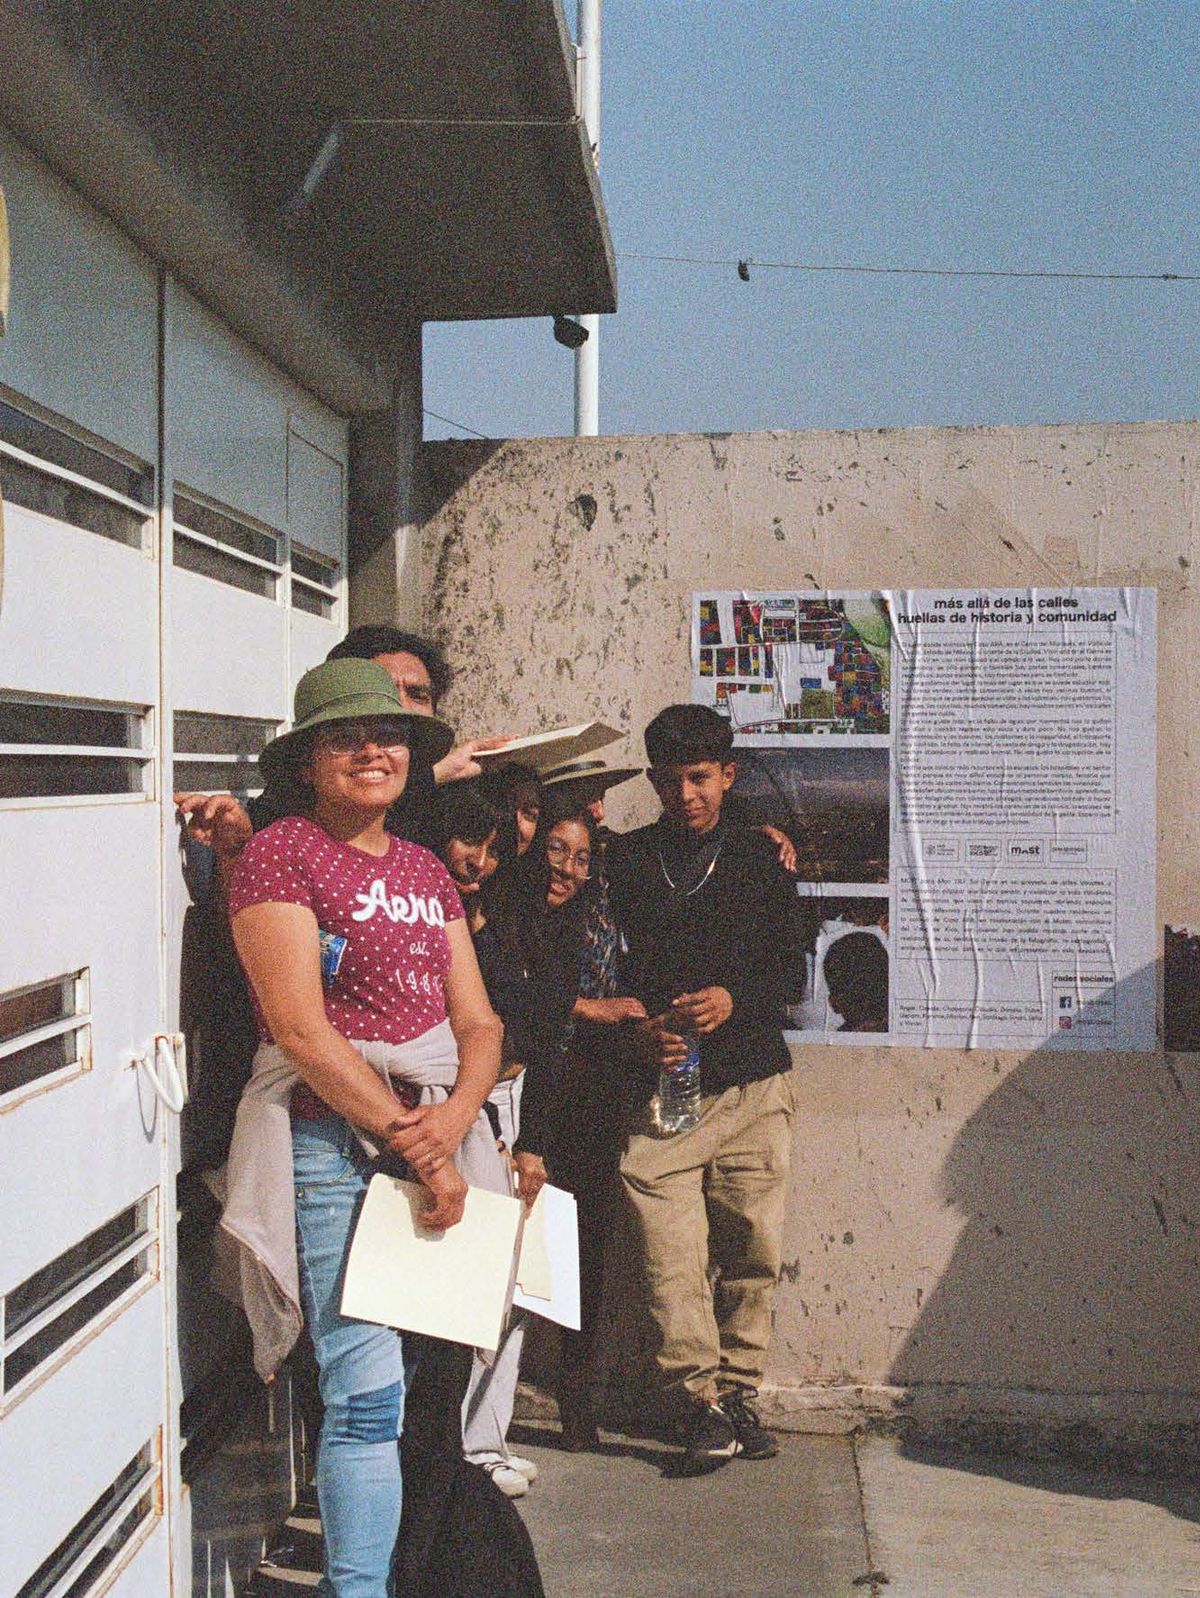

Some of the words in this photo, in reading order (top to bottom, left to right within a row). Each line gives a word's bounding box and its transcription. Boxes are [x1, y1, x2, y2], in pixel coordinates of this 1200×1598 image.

[934, 597, 963, 609] más
[967, 597, 989, 609] allá
[993, 597, 1011, 609] de
[1015, 597, 1034, 609] las
[1038, 596, 1079, 608] calles
[898, 612, 946, 624] huellas
[949, 612, 967, 624] de
[970, 611, 1023, 623] historia
[1026, 613, 1034, 625] y
[1038, 610, 1117, 622] comunidad
[351, 879, 446, 928] Aero
[394, 968, 441, 994] 1987
[1054, 974, 1077, 983] redes
[1079, 974, 1115, 984] sociales
